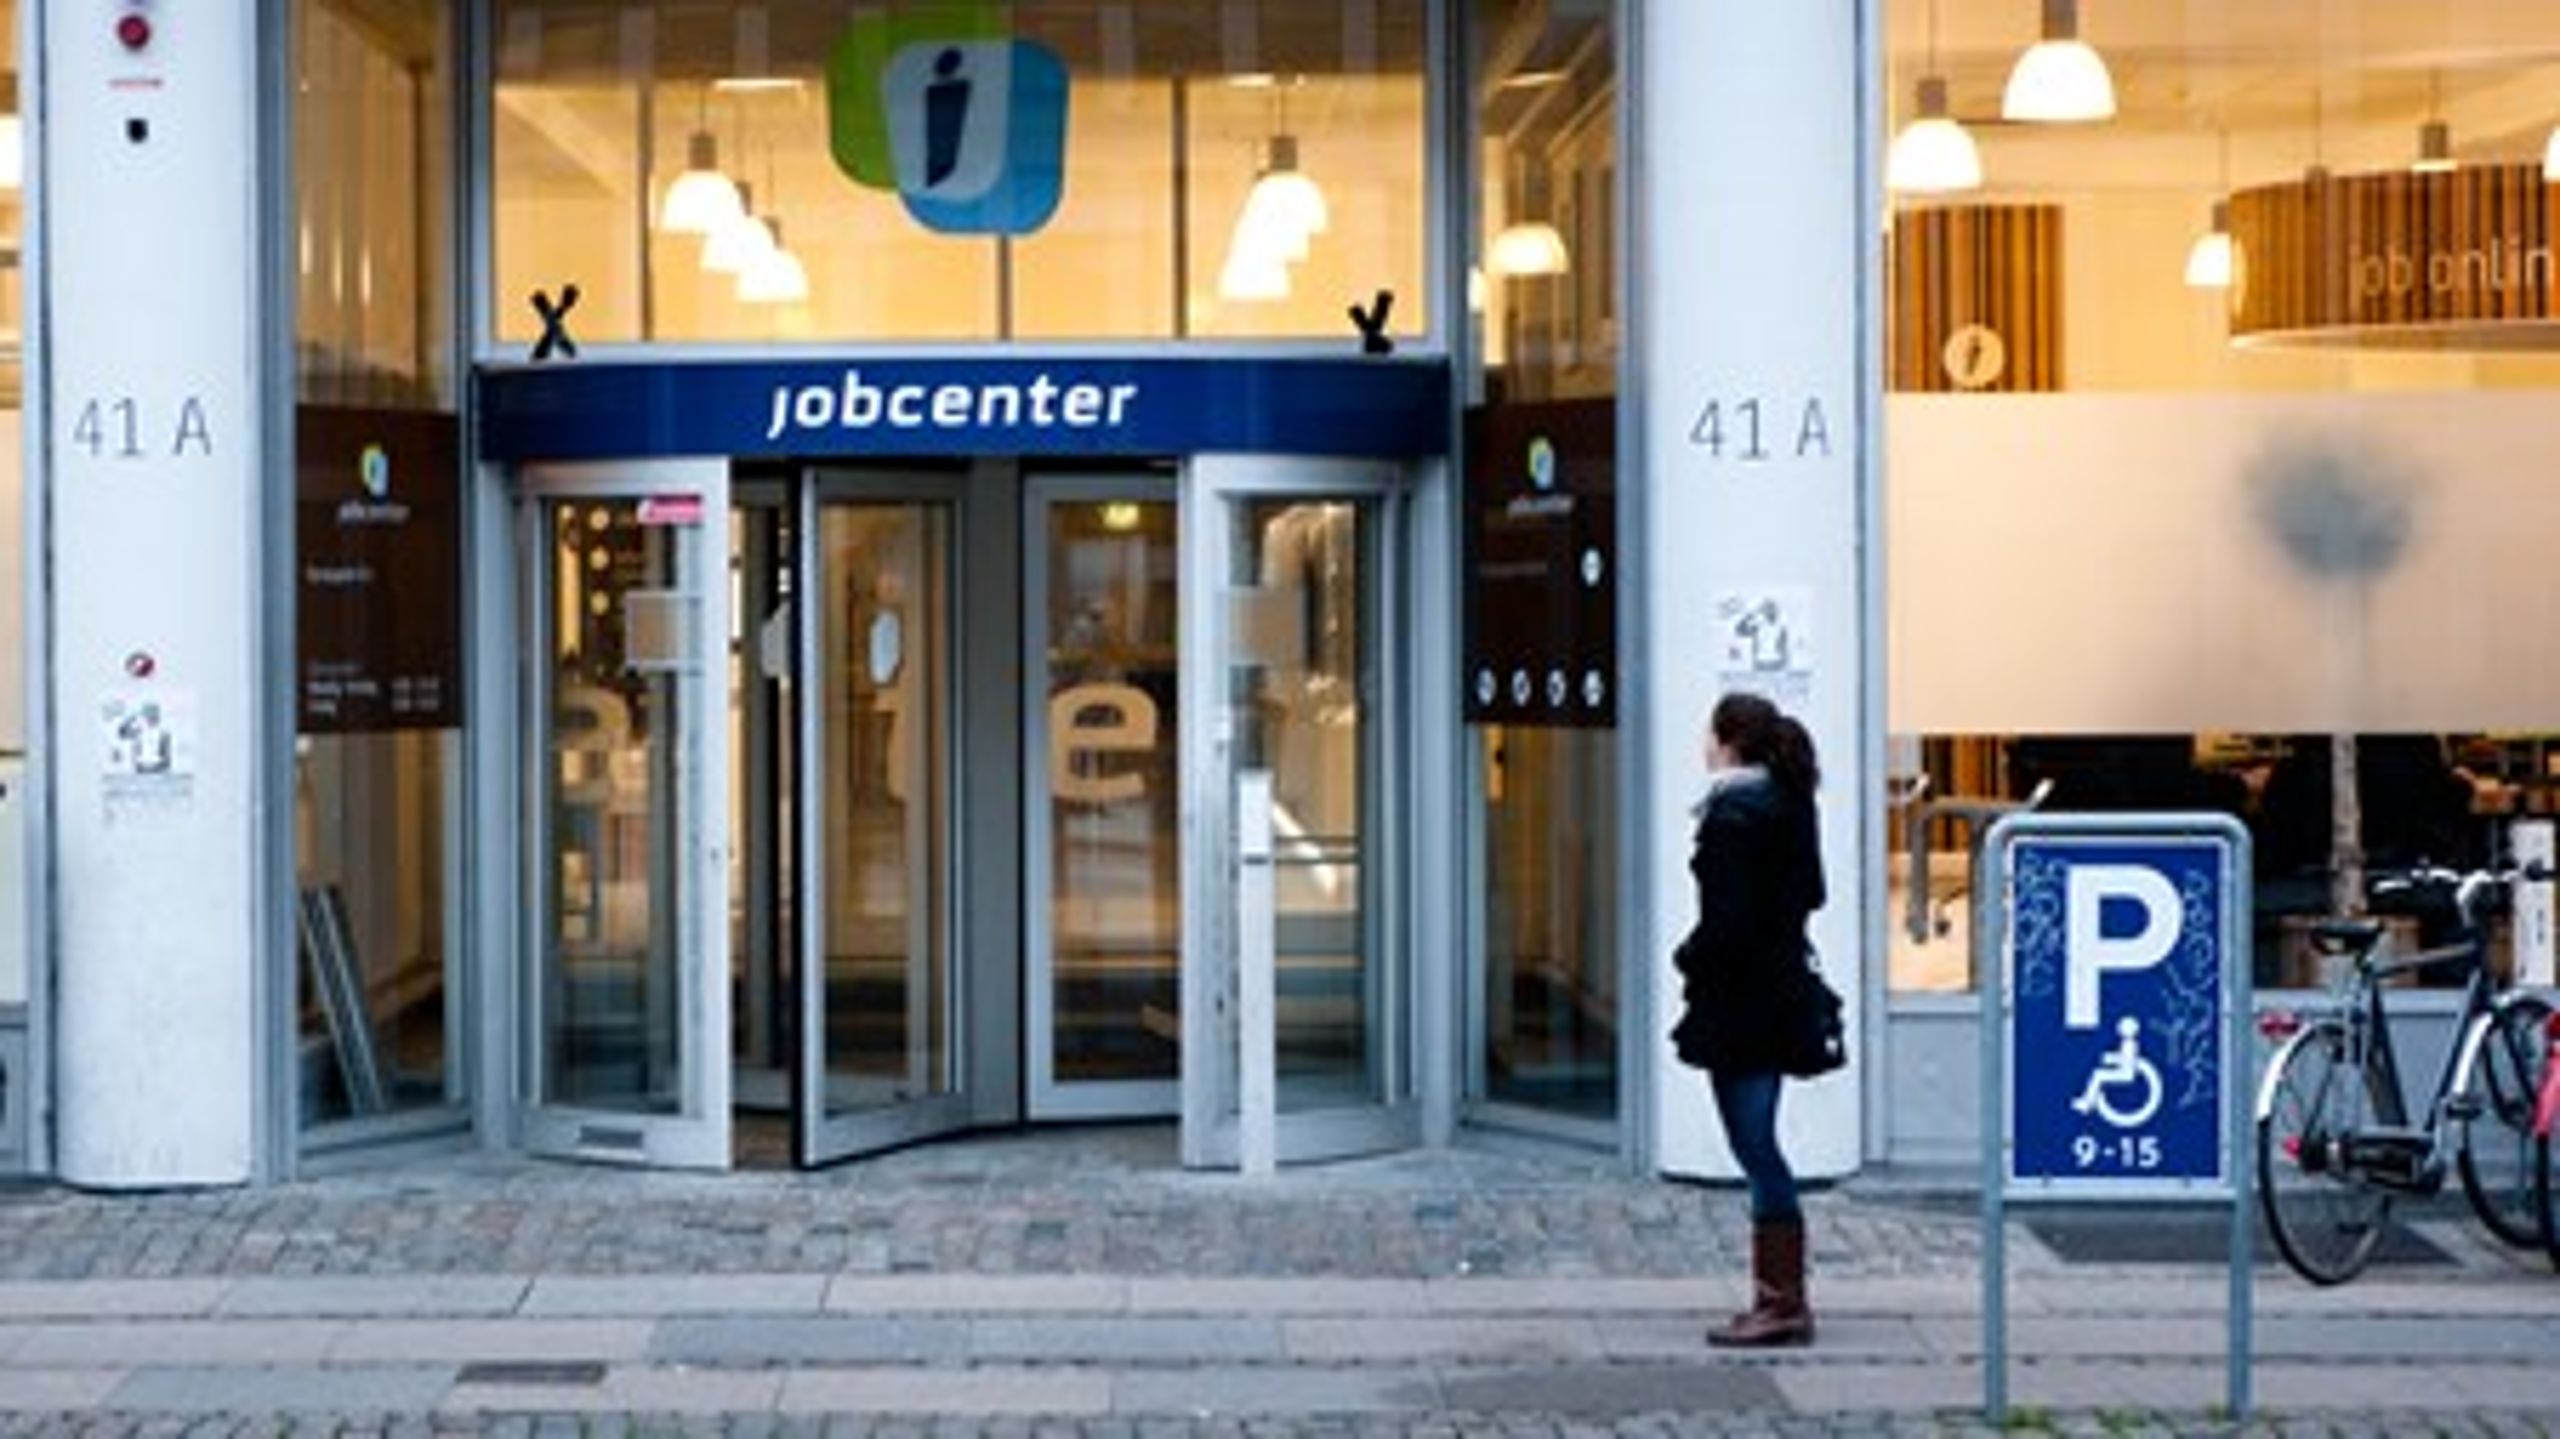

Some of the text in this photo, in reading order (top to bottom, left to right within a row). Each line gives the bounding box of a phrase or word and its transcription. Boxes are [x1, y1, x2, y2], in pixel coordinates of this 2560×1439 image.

[73, 397, 212, 460] 41 A
[766, 369, 1137, 440] jobcenter
[1689, 397, 1832, 461] 41 A
[2065, 864, 2184, 1028] P
[2073, 1137, 2161, 1168] 9-15
